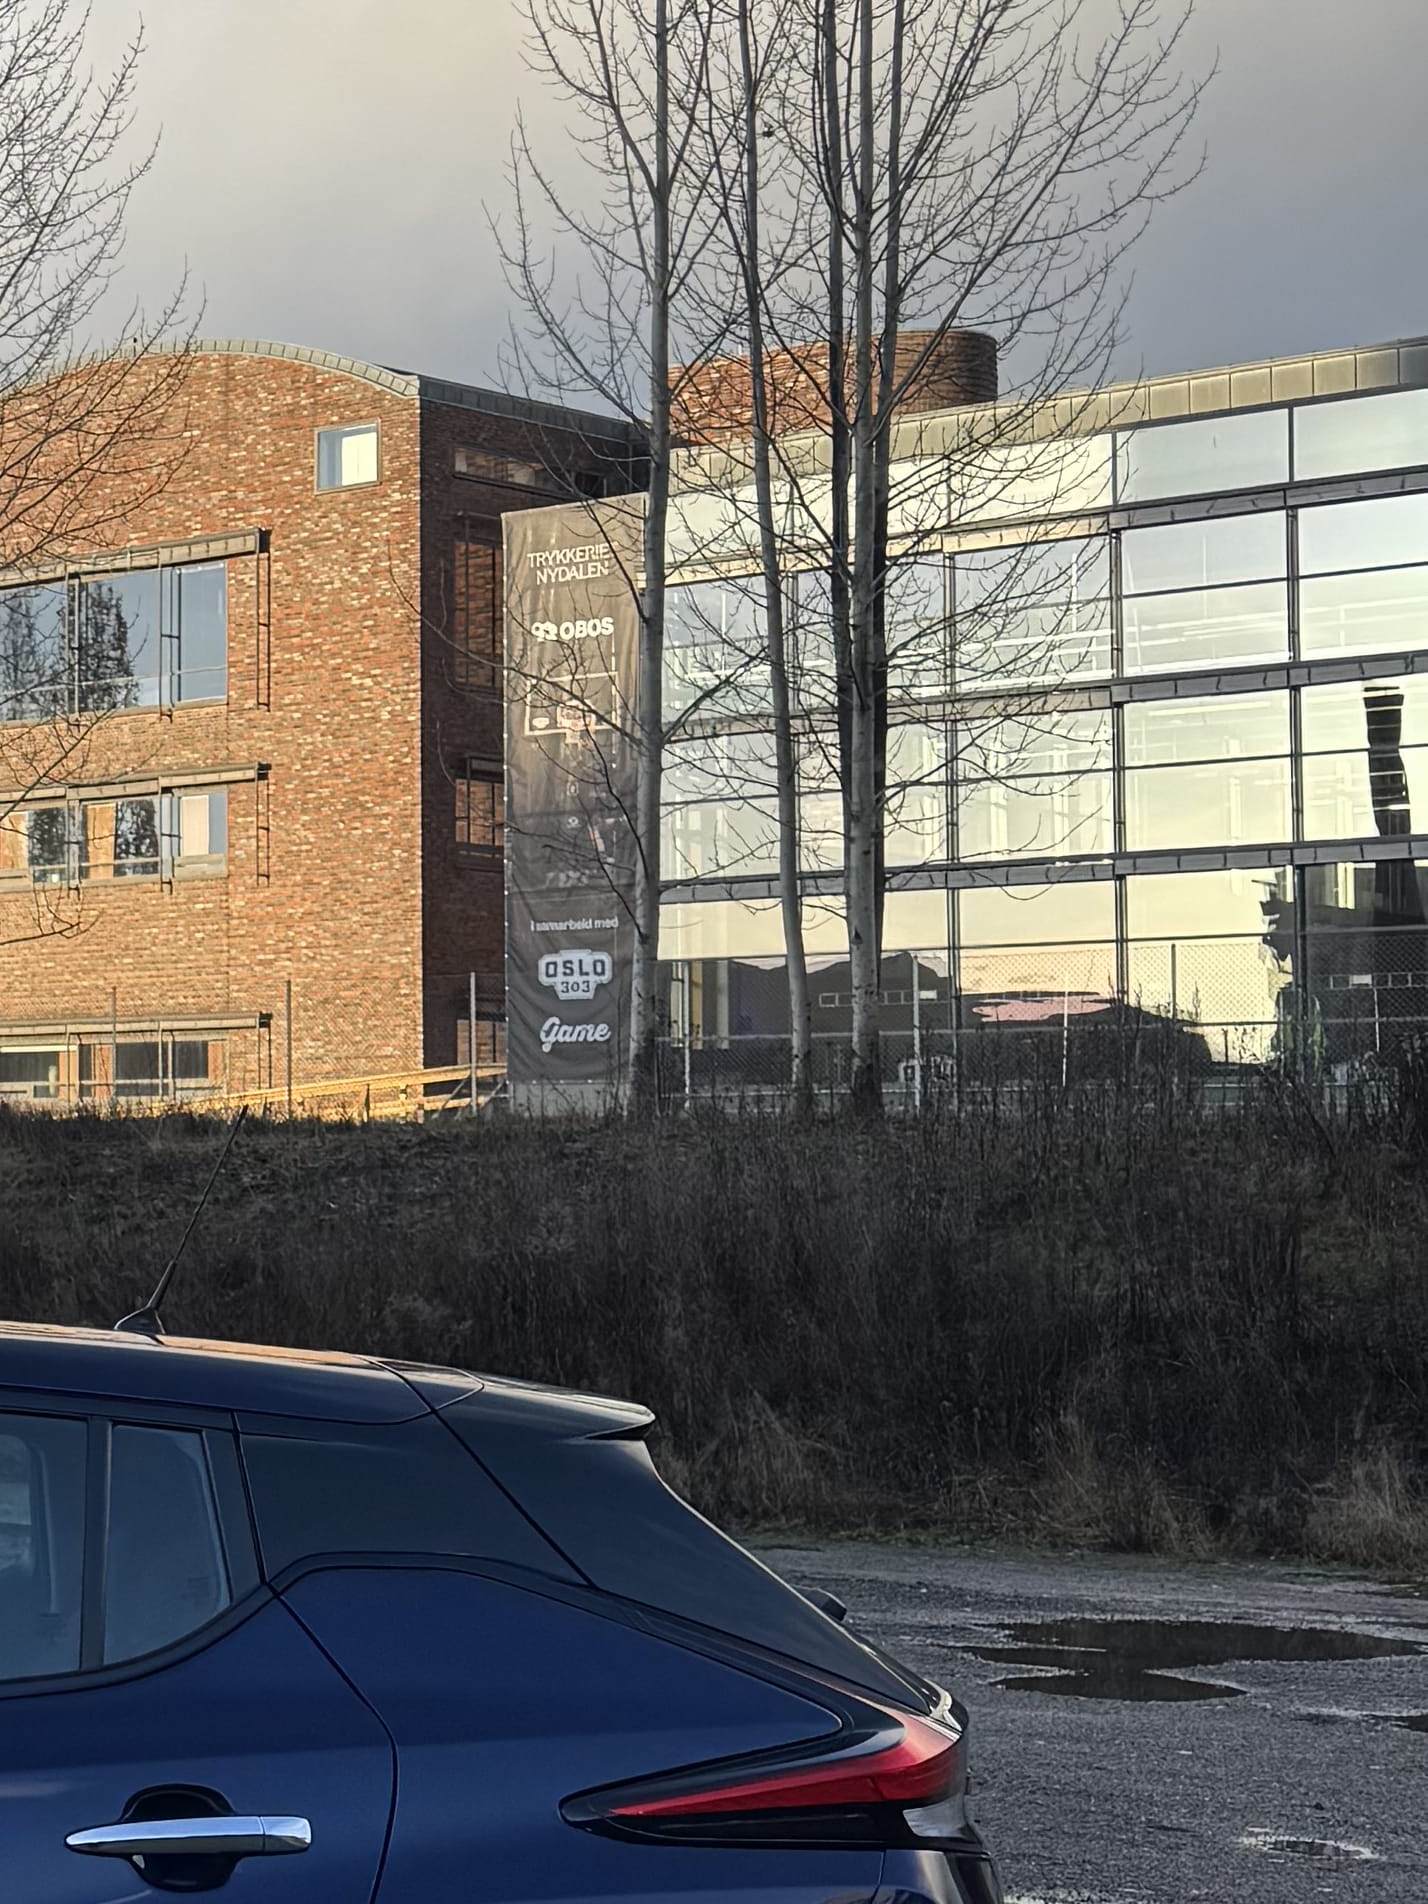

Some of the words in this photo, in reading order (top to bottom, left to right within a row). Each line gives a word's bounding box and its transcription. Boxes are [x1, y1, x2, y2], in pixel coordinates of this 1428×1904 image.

[536, 561, 608, 584] NYDALEN
[560, 617, 614, 639] OBOS
[594, 915, 618, 929] med
[545, 959, 606, 977] OSLO
[561, 981, 591, 993] 303
[540, 1016, 611, 1052] Game
